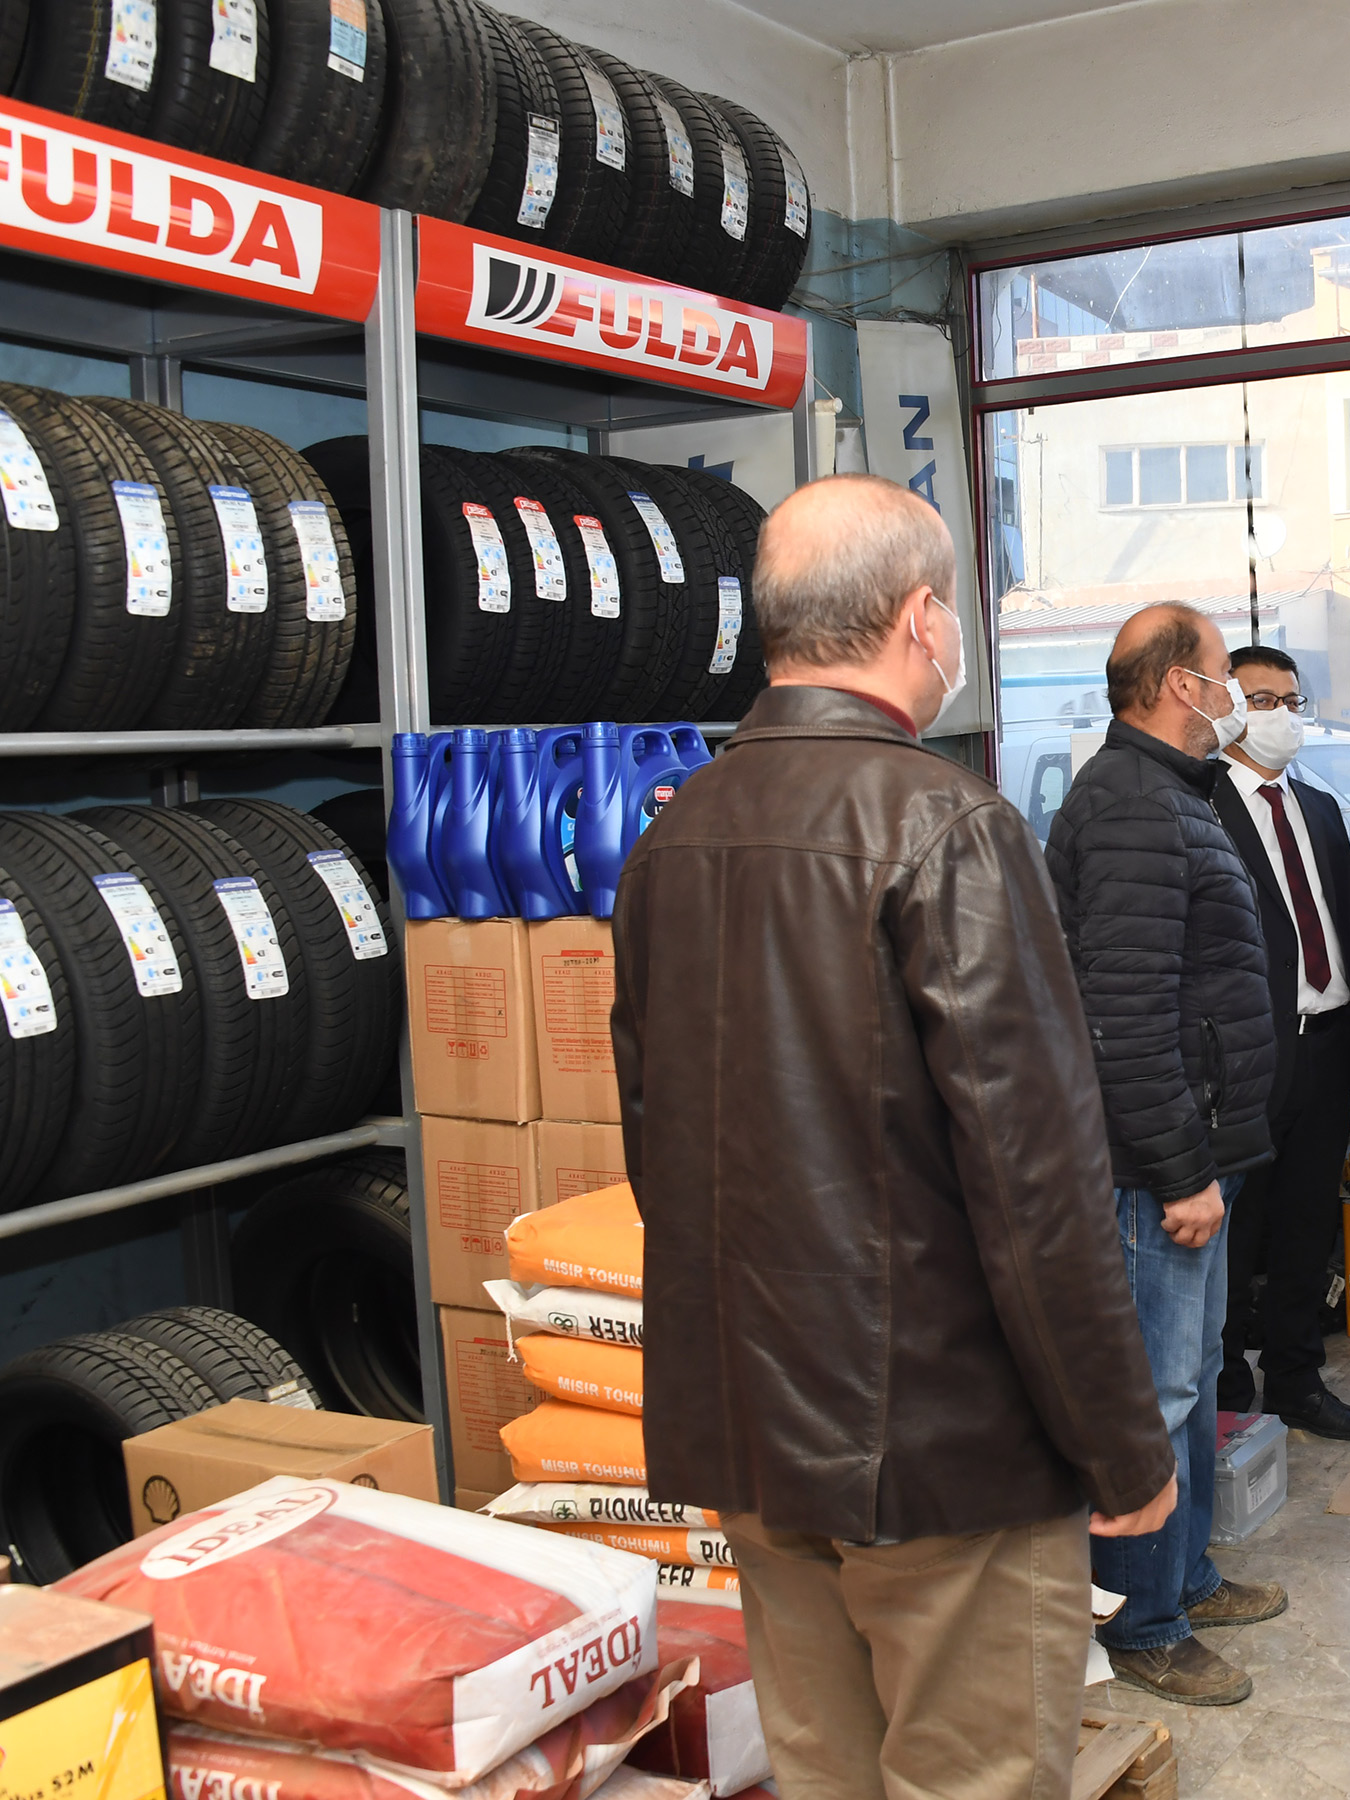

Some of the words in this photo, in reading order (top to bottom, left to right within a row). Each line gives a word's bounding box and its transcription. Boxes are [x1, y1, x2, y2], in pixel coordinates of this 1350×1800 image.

[0, 127, 303, 280] ULDA
[540, 275, 760, 381] FULDA
[543, 1258, 583, 1278] MISIR
[557, 1376, 600, 1397] MISIR
[540, 1458, 581, 1474] MISIR
[589, 1497, 689, 1524] PIONEER
[608, 1533, 671, 1554] TOHUMU
